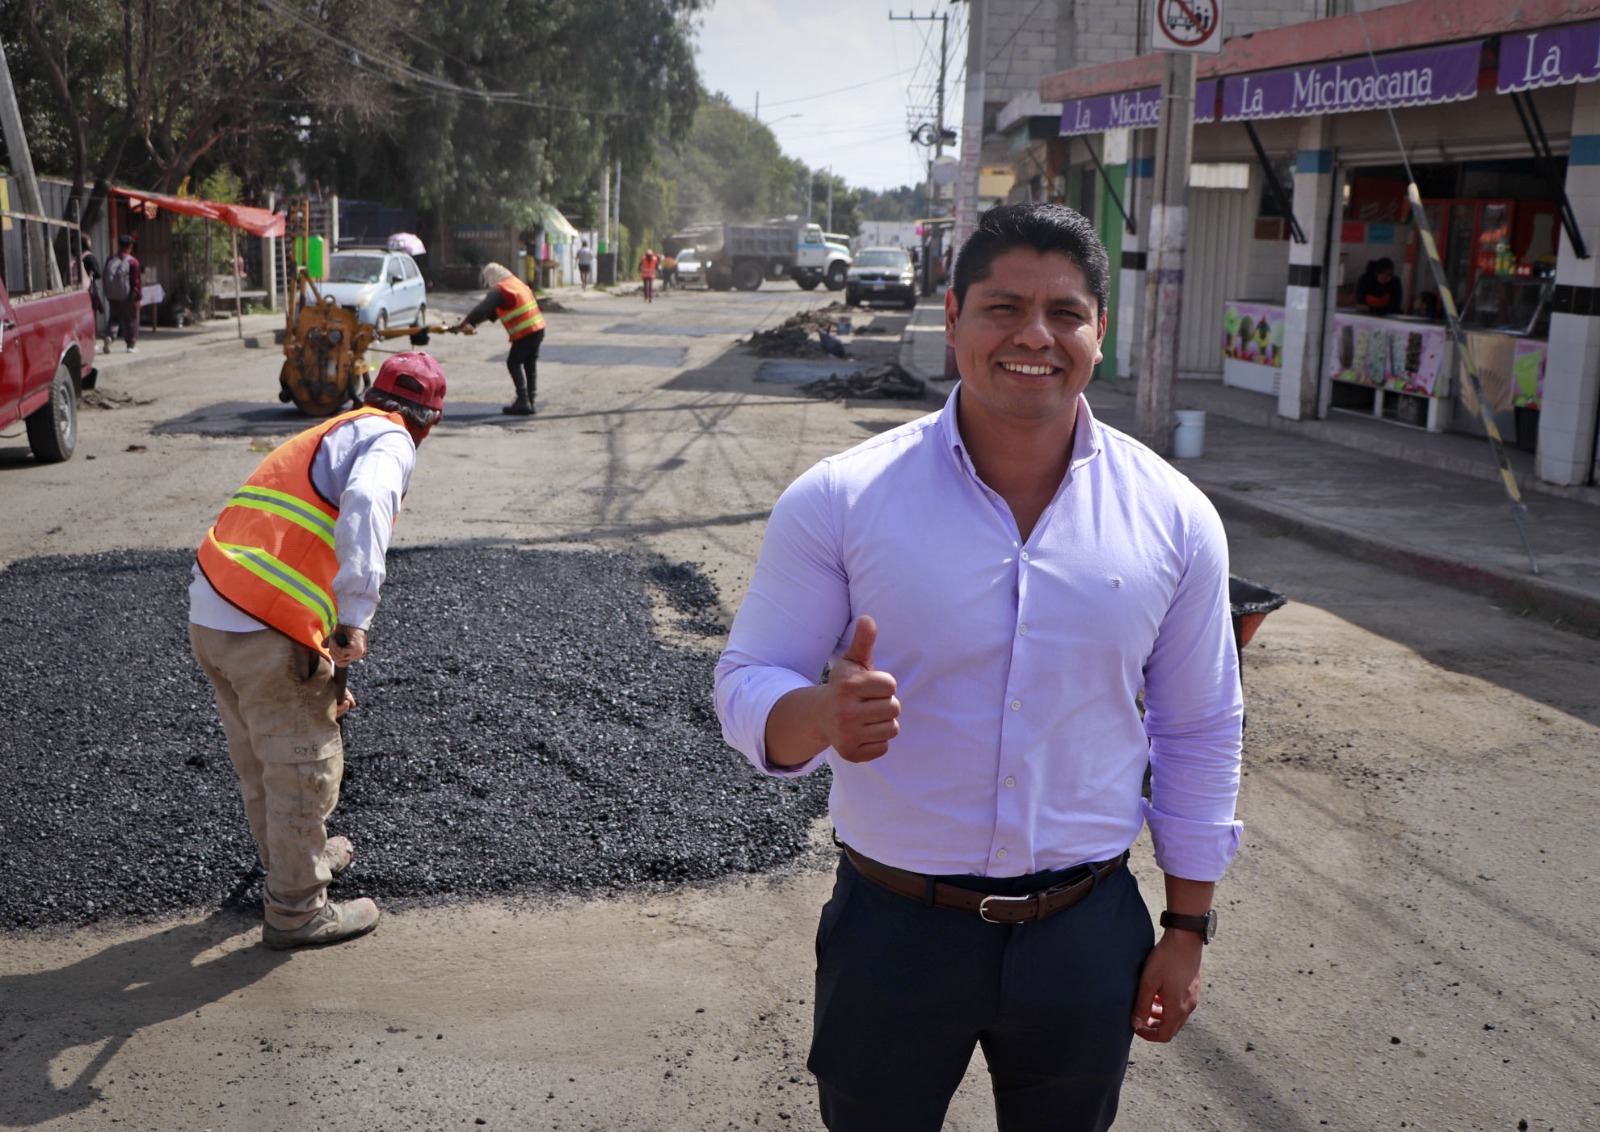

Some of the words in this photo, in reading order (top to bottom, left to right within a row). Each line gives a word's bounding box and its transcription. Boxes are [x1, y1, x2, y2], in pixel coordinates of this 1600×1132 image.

[1522, 33, 1561, 81] La
[1074, 99, 1091, 130] La
[1108, 91, 1161, 126] Michoa
[1241, 78, 1263, 113] La
[1292, 65, 1433, 109] Michoacana
